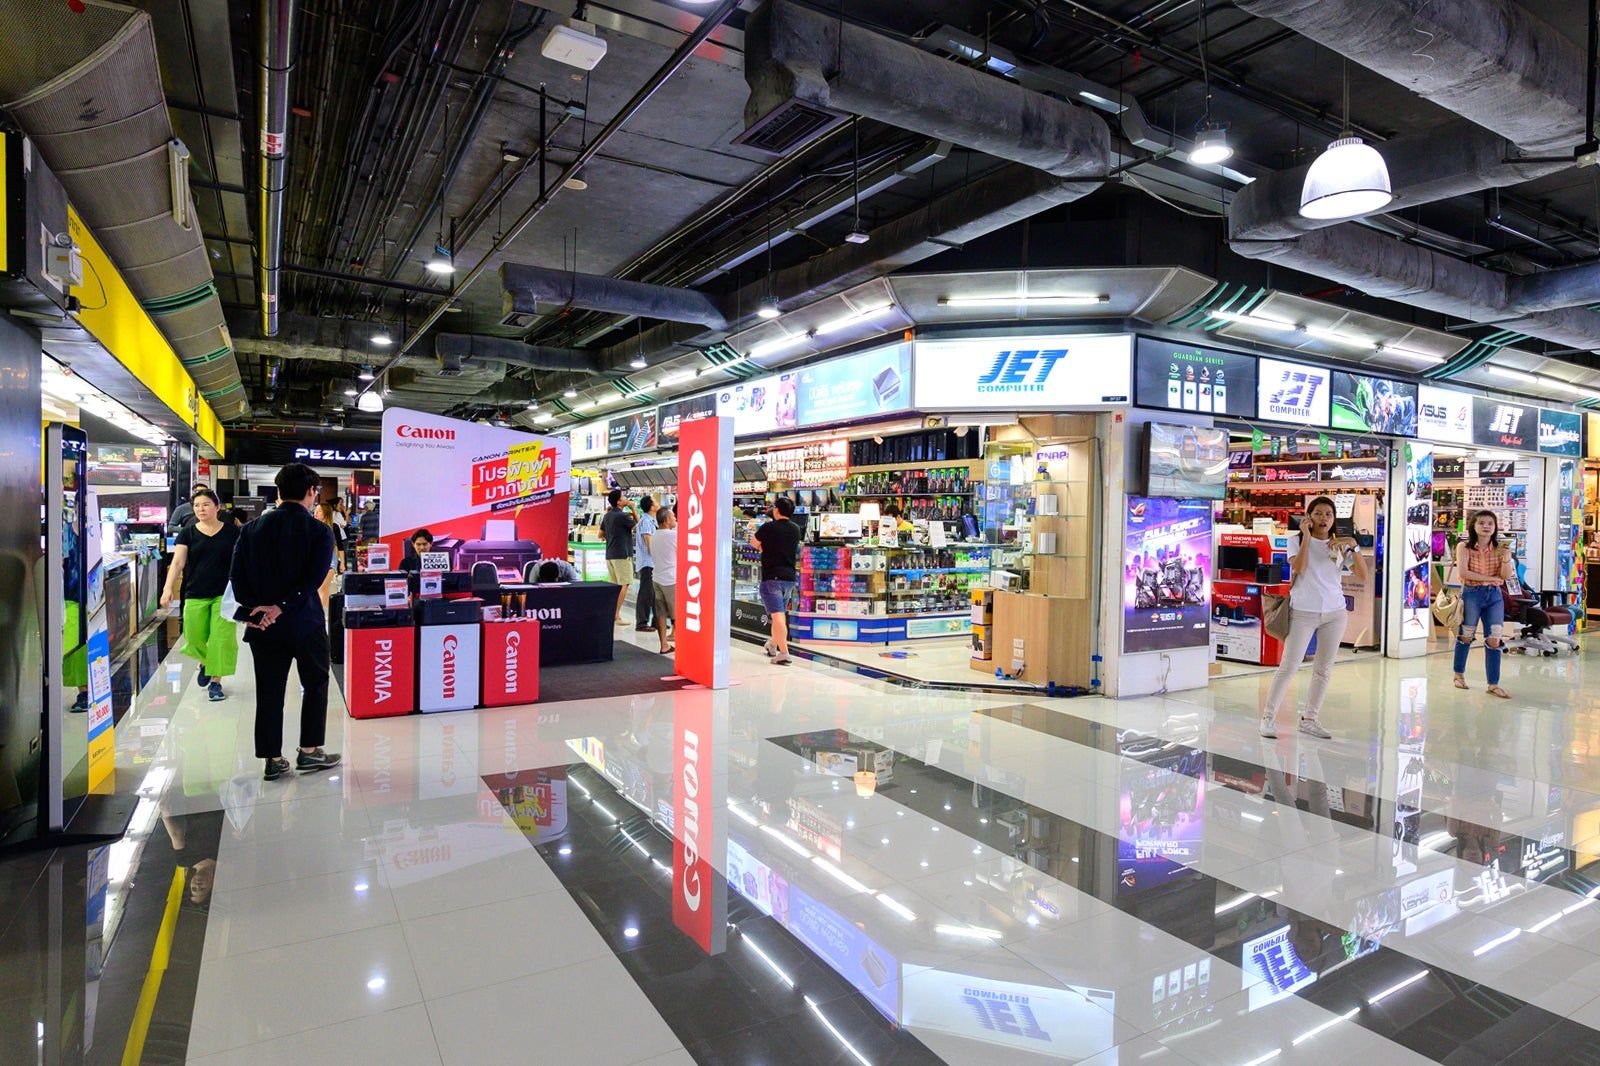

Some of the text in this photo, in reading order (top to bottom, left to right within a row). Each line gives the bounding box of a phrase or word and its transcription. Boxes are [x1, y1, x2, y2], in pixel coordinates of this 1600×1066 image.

[977, 349, 1069, 384] JET
[1173, 352, 1224, 365] GUARDIAN SERIES
[977, 384, 1044, 393] COMPUTER
[1269, 370, 1324, 408] JET
[1270, 404, 1310, 417] COMPUTER
[1419, 403, 1447, 420] ASUS
[662, 414, 681, 427] ASUS
[1488, 404, 1524, 435] JET
[396, 424, 456, 440] Canon
[395, 441, 424, 450] Delighting
[295, 448, 382, 461] PEZLATO
[471, 445, 537, 463] CANON PRINTER
[1344, 468, 1382, 477] CORSAIR
[1481, 461, 1513, 473] JET
[685, 449, 707, 633] Canon
[526, 606, 562, 621] non
[442, 634, 458, 699] Canon
[505, 630, 521, 693] Canon
[375, 639, 393, 704] PIXMA
